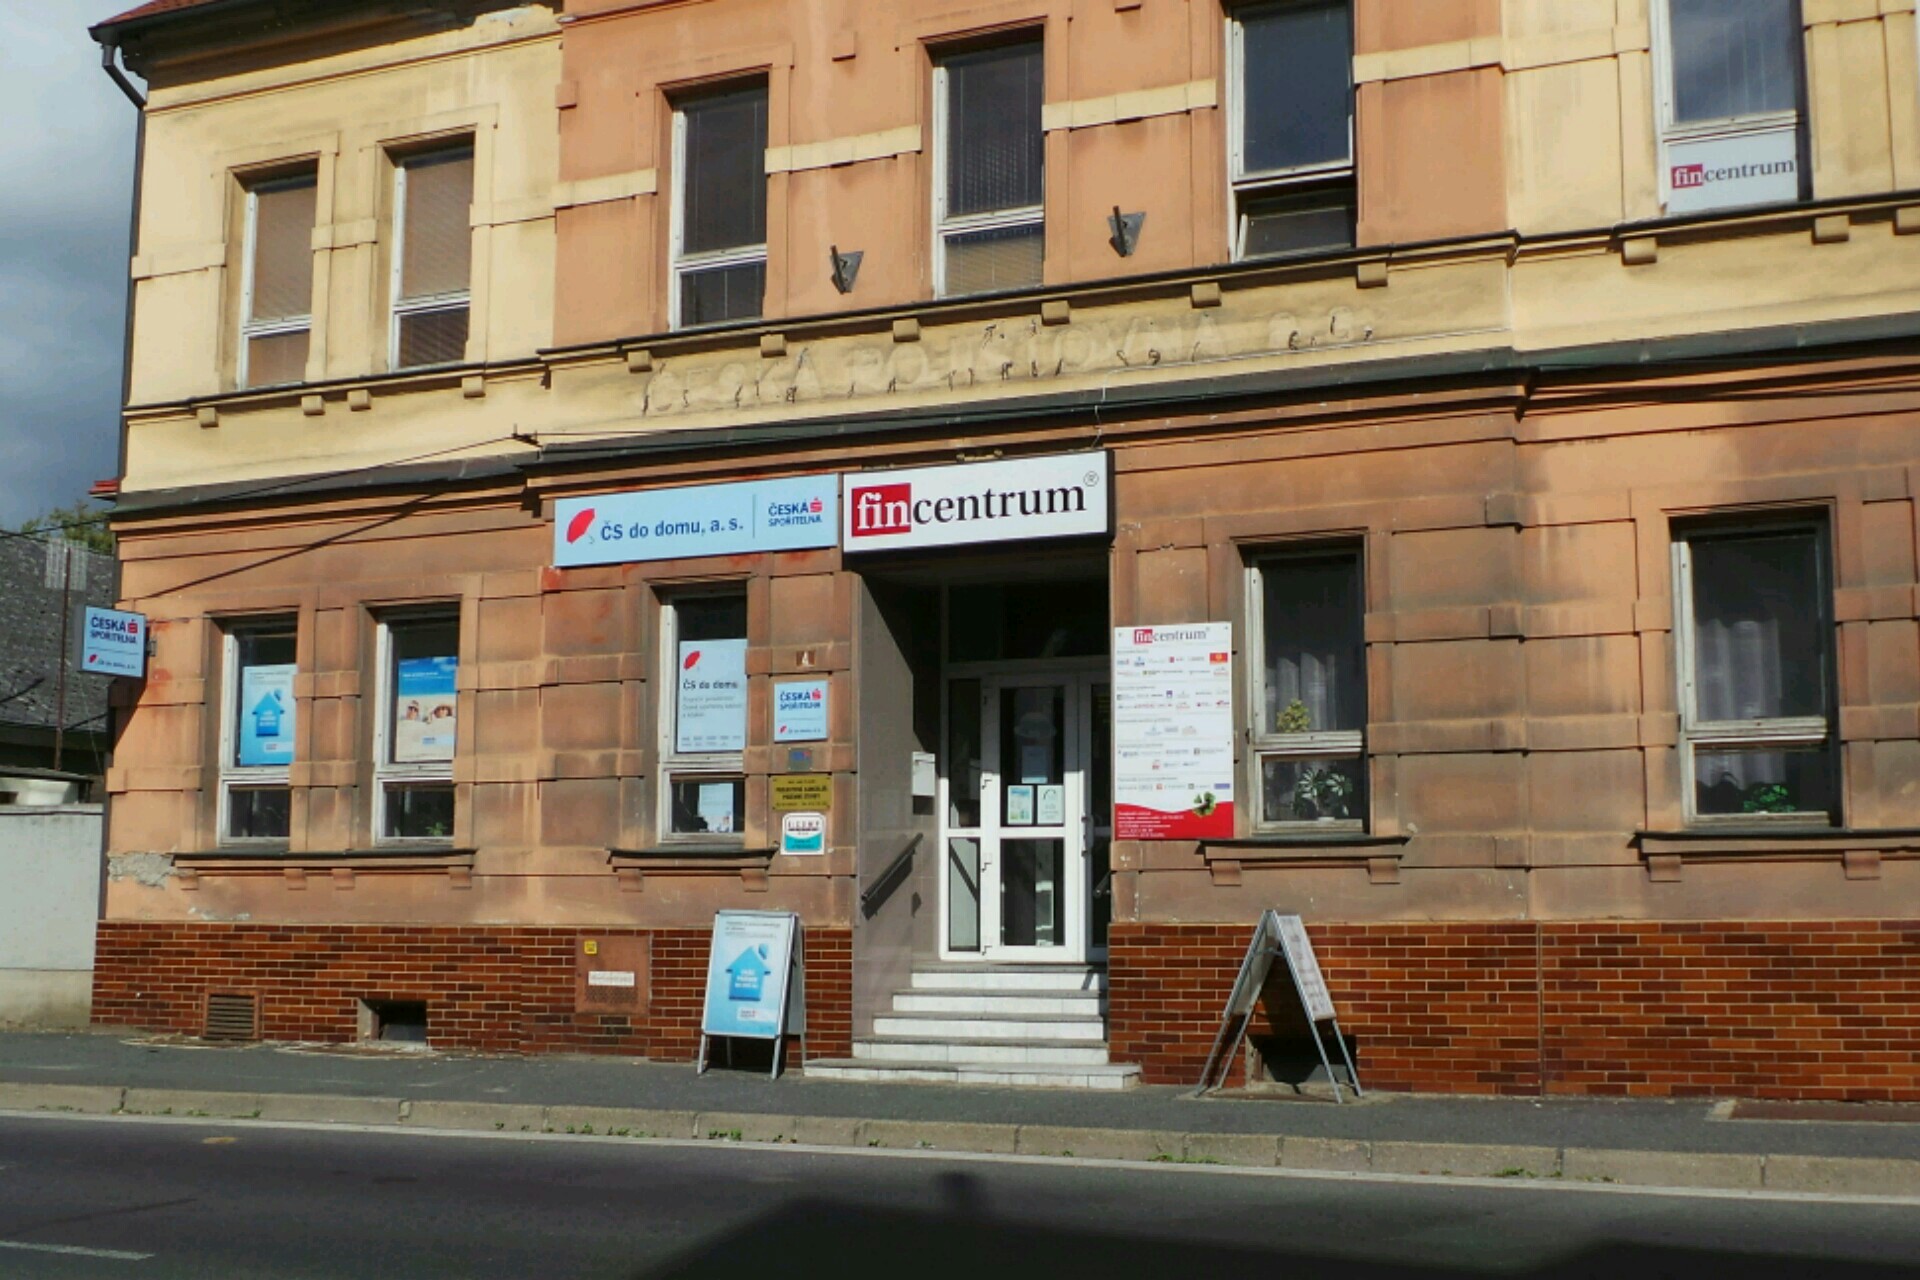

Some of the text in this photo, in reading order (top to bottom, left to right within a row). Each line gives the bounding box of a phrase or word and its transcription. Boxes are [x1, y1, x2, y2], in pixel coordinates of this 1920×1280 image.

[1673, 160, 1795, 187] fincentrum
[768, 499, 809, 517] ČESKÁ
[601, 518, 744, 541] ČS do domu, a. s.
[90, 613, 127, 633] ČESKÁ
[1135, 630, 1206, 644] fincentrum
[780, 689, 811, 702] ČESKÁ
